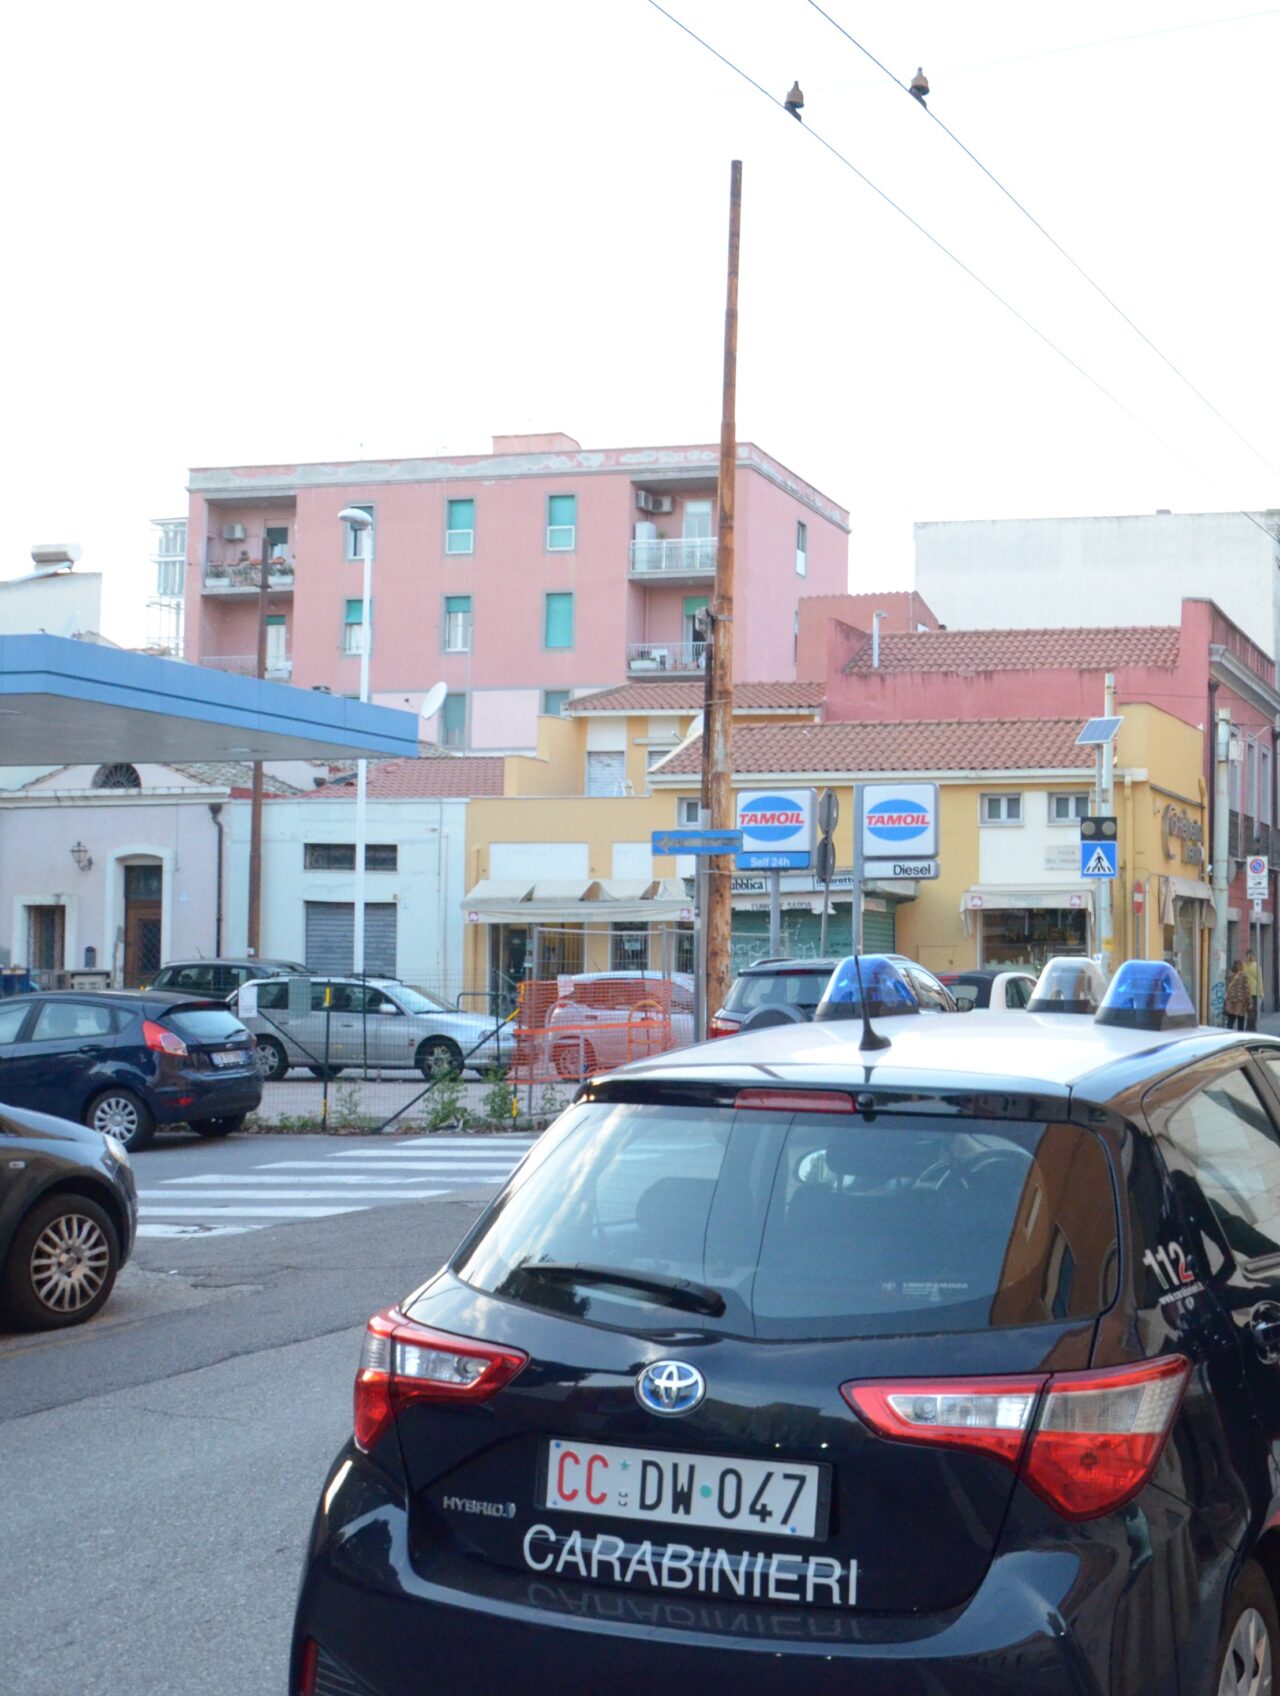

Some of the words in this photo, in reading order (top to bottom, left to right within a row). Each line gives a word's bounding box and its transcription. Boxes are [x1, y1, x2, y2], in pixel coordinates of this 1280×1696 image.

[739, 812, 805, 825] TAMOIL
[866, 814, 930, 826] TAMOIL
[750, 857, 769, 868] Self
[771, 856, 790, 868] 24h
[893, 863, 932, 876] Diesel
[1142, 1241, 1195, 1290] 112
[556, 1450, 609, 1505] CC
[638, 1459, 696, 1516] DW
[717, 1468, 807, 1527] 047
[442, 1495, 505, 1517] HYBRID
[522, 1523, 859, 1606] CARABINIERI
